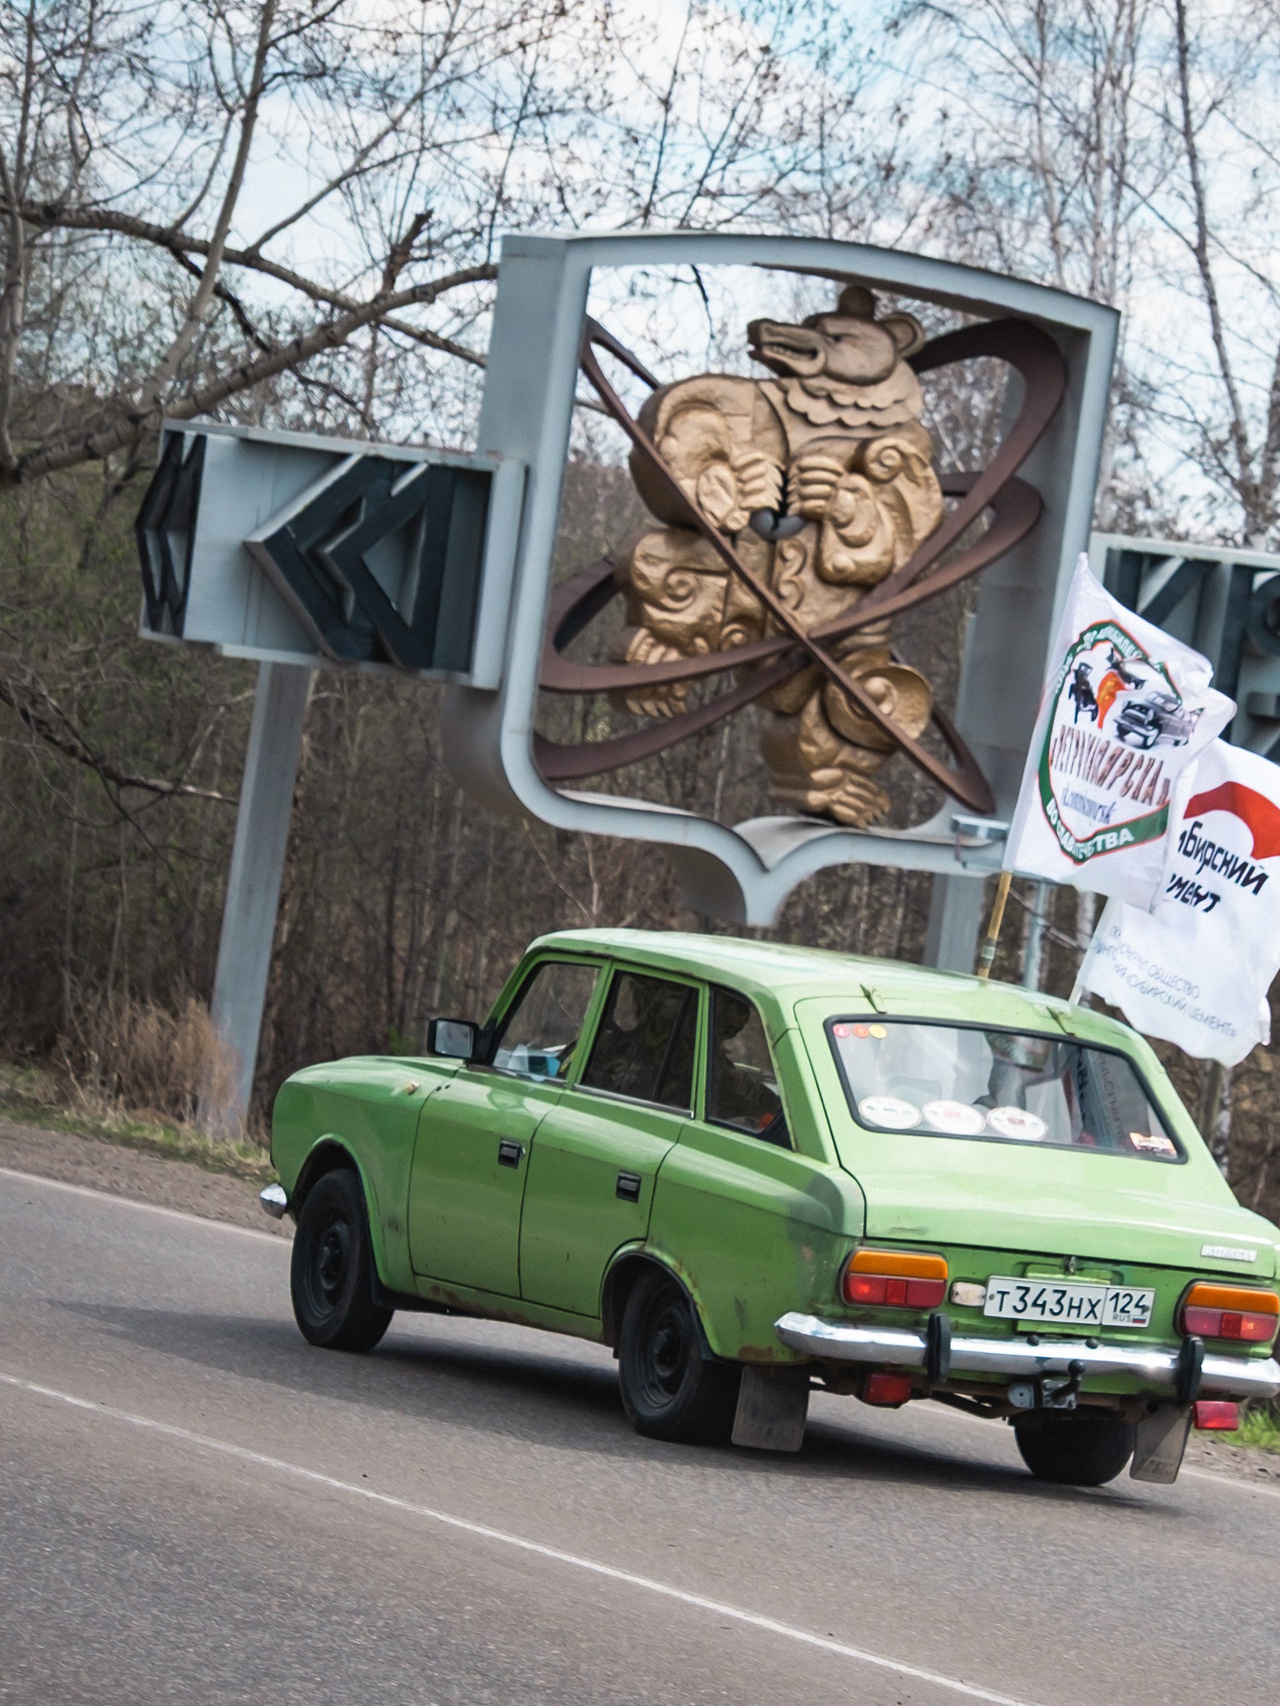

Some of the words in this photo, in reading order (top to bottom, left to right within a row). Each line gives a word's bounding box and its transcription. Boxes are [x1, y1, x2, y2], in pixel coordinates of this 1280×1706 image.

[1178, 820, 1269, 895] бирский
[997, 1286, 1101, 1319] Т343НХ
[1109, 1292, 1150, 1314] 124
[1113, 1314, 1131, 1322] RUS
